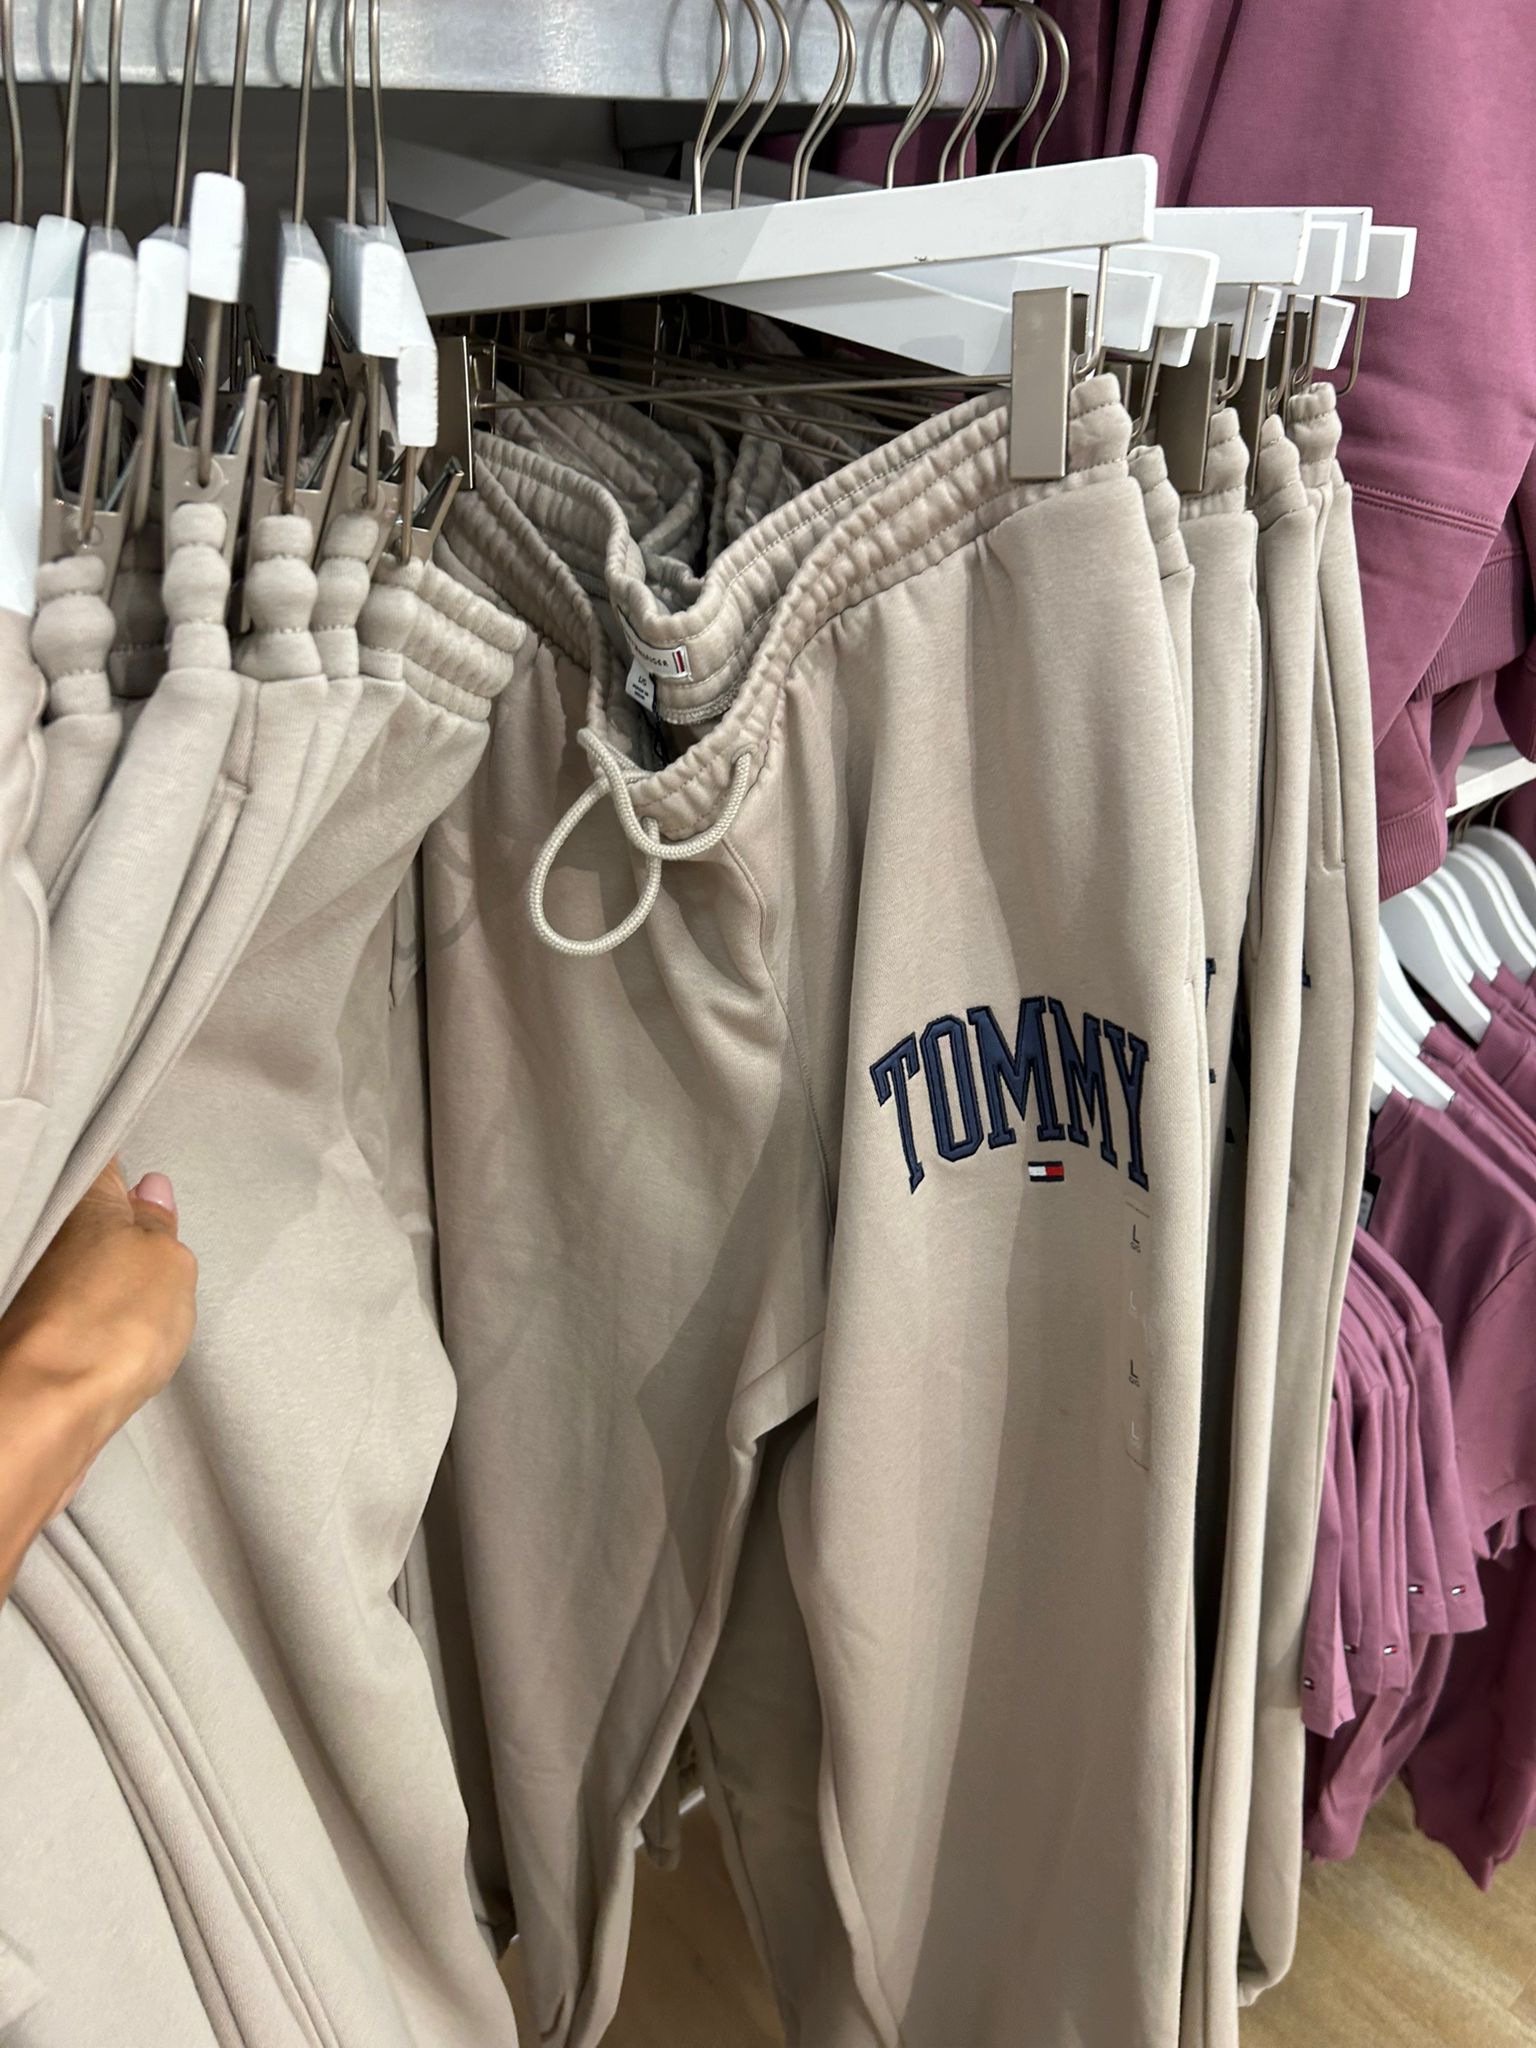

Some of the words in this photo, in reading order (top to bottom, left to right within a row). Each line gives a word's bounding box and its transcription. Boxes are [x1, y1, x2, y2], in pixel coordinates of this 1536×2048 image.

[869, 996, 1149, 1195] TOMMY
[1132, 1223, 1140, 1244] L
[1130, 1359, 1139, 1379] L
